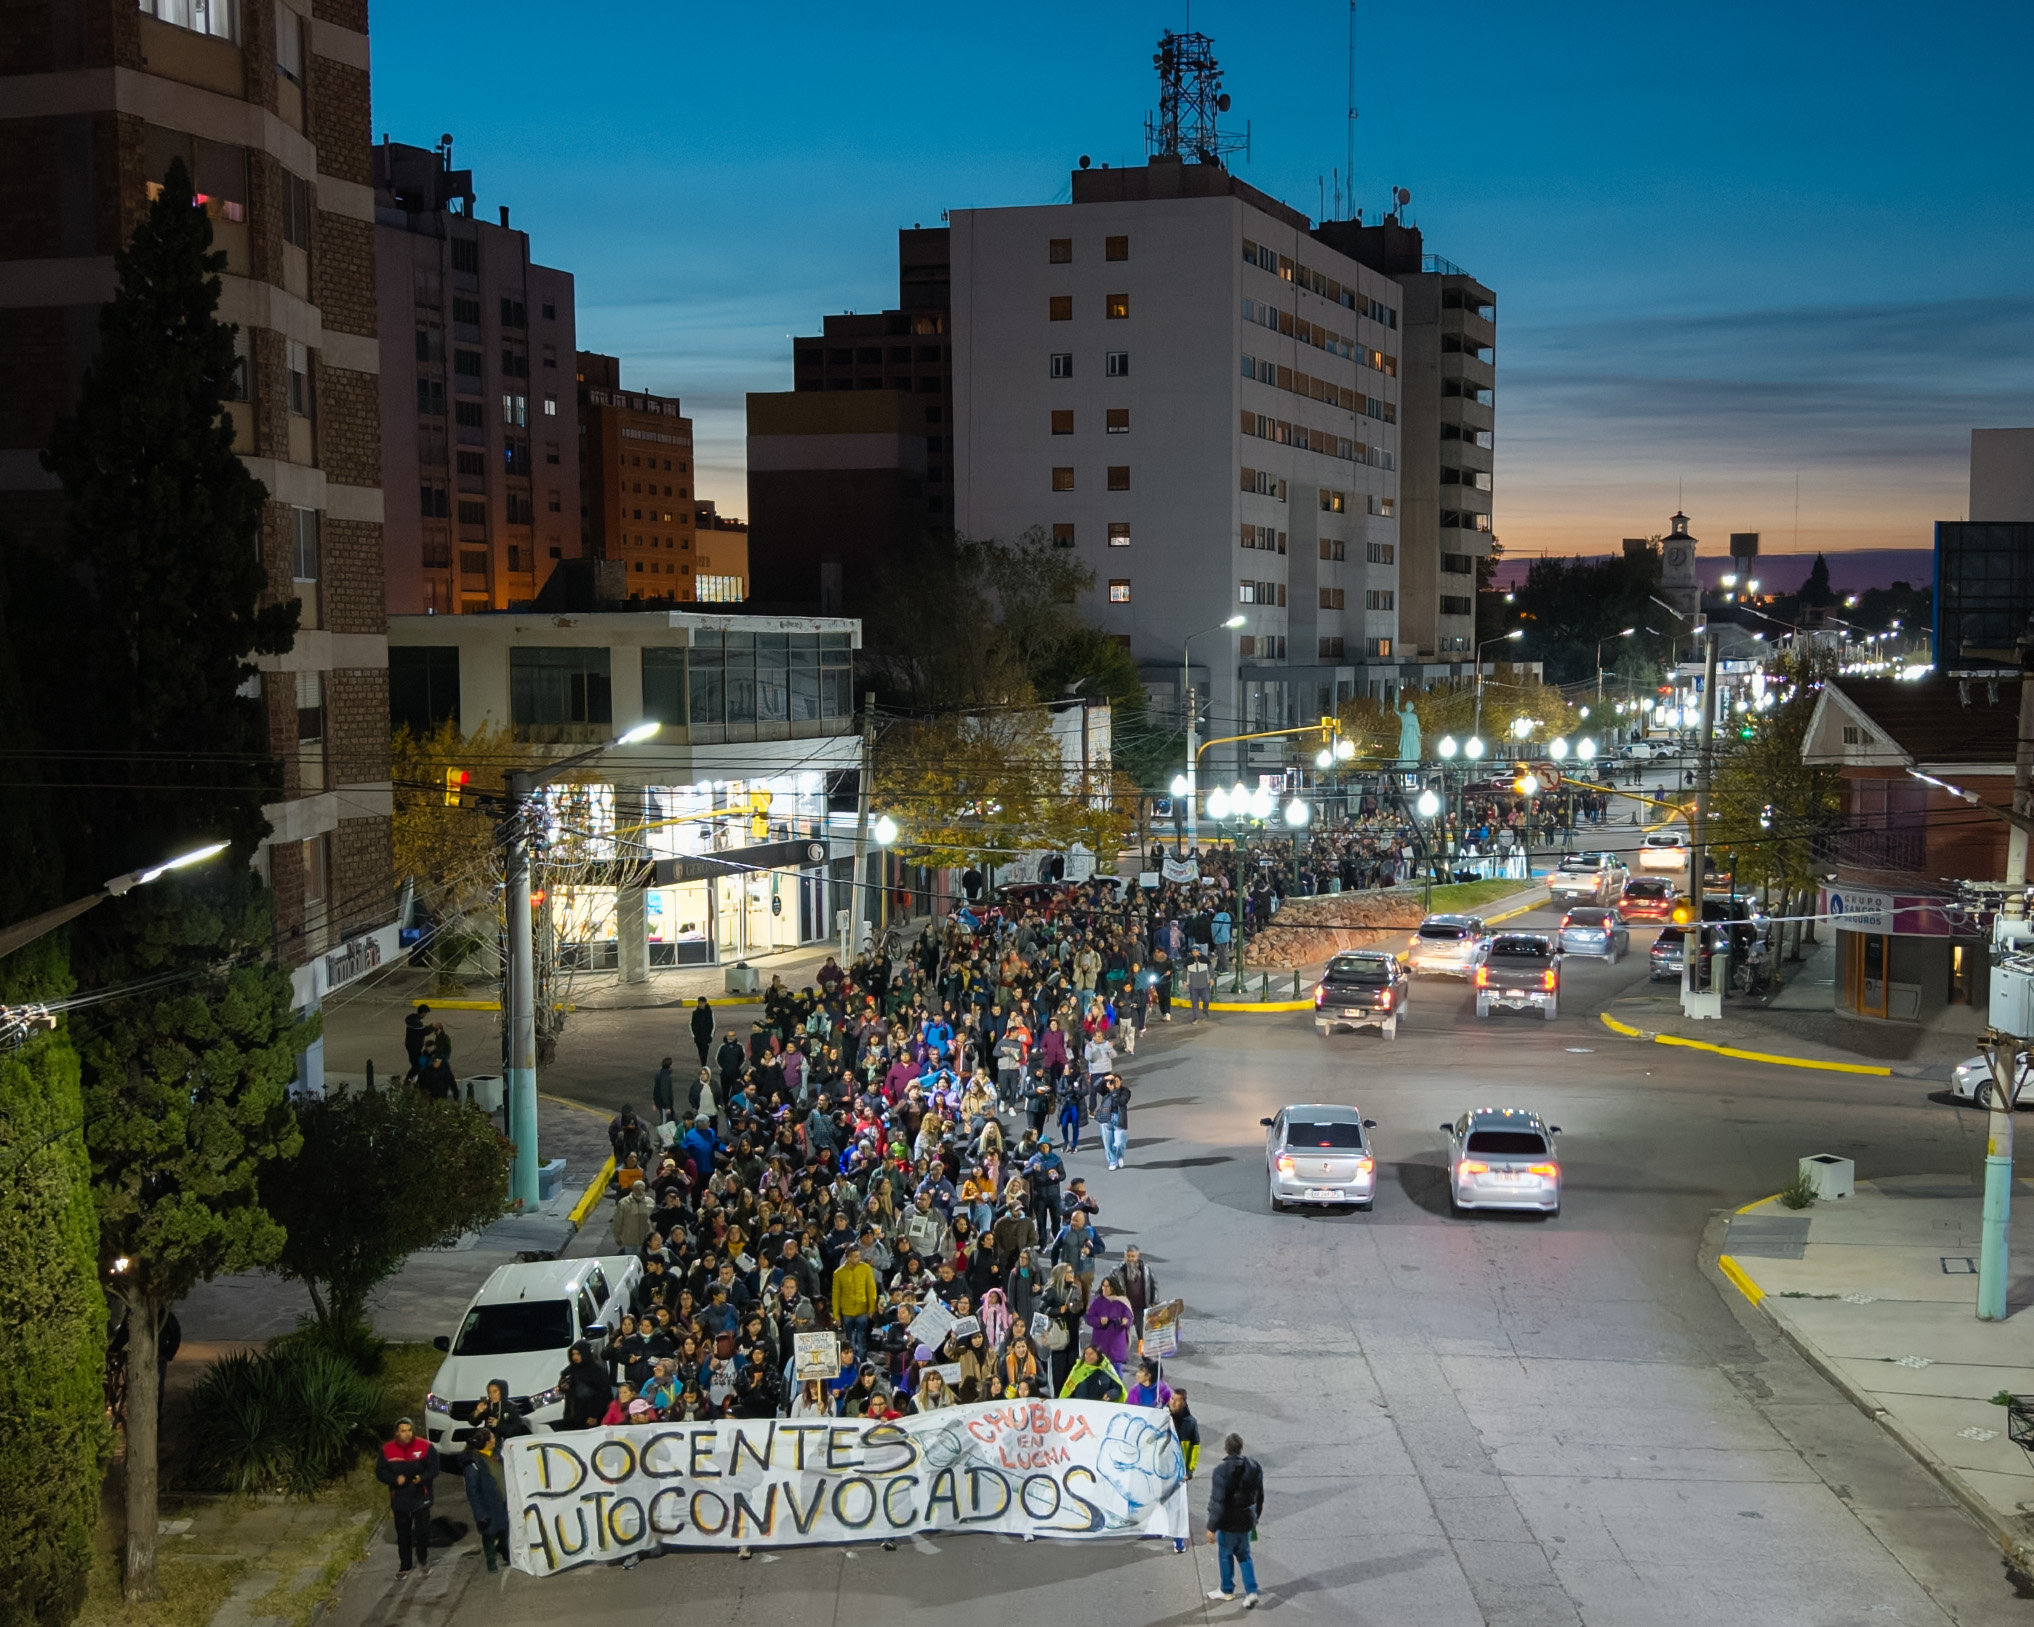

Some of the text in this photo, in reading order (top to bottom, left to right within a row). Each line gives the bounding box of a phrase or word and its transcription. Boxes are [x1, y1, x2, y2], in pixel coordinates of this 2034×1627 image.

[1844, 895, 1882, 906] GRUPO
[967, 1402, 1096, 1444] CHUBUT
[998, 1445, 1071, 1470] LUCHA
[1017, 1434, 1043, 1448] EN
[527, 1420, 921, 1499] DOCENTES
[523, 1465, 1106, 1569] AUTOCONVOCADOS
